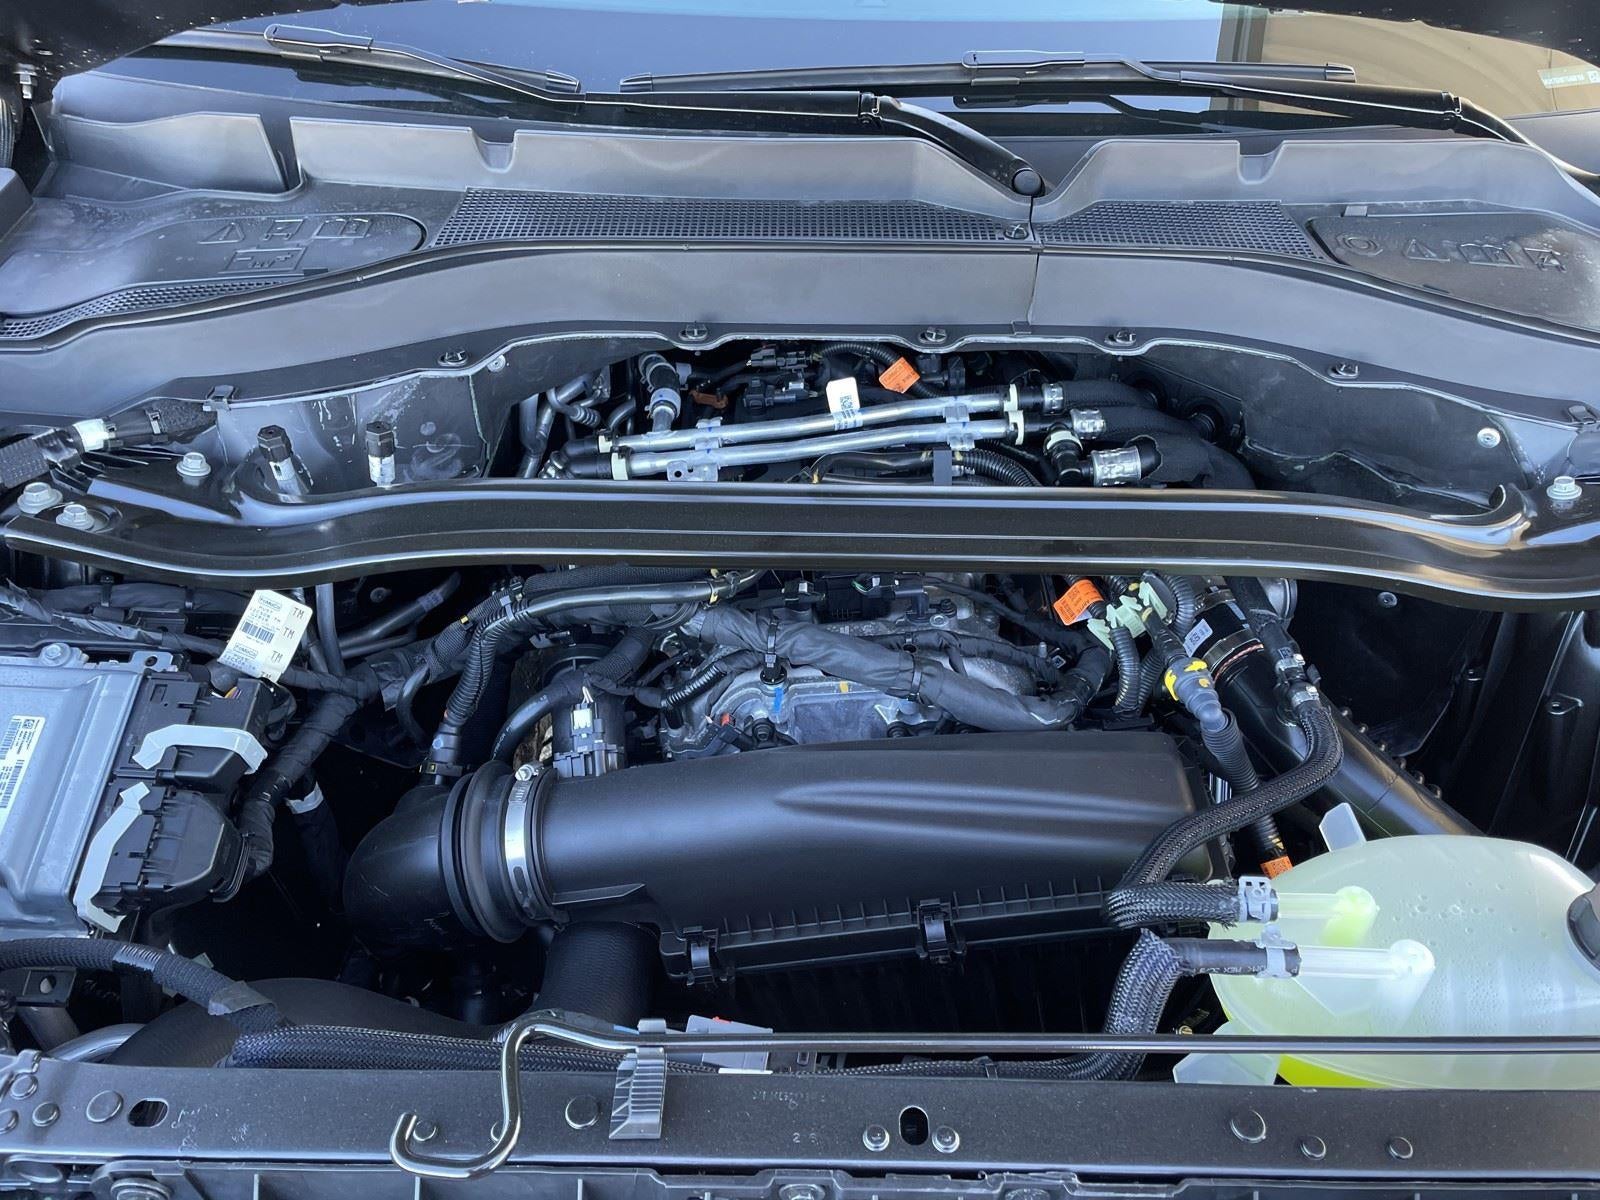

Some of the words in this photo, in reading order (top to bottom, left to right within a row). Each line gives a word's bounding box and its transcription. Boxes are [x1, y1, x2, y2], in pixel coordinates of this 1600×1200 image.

[291, 607, 305, 620] TM
[282, 627, 295, 639] TM
[270, 650, 284, 663] TM
